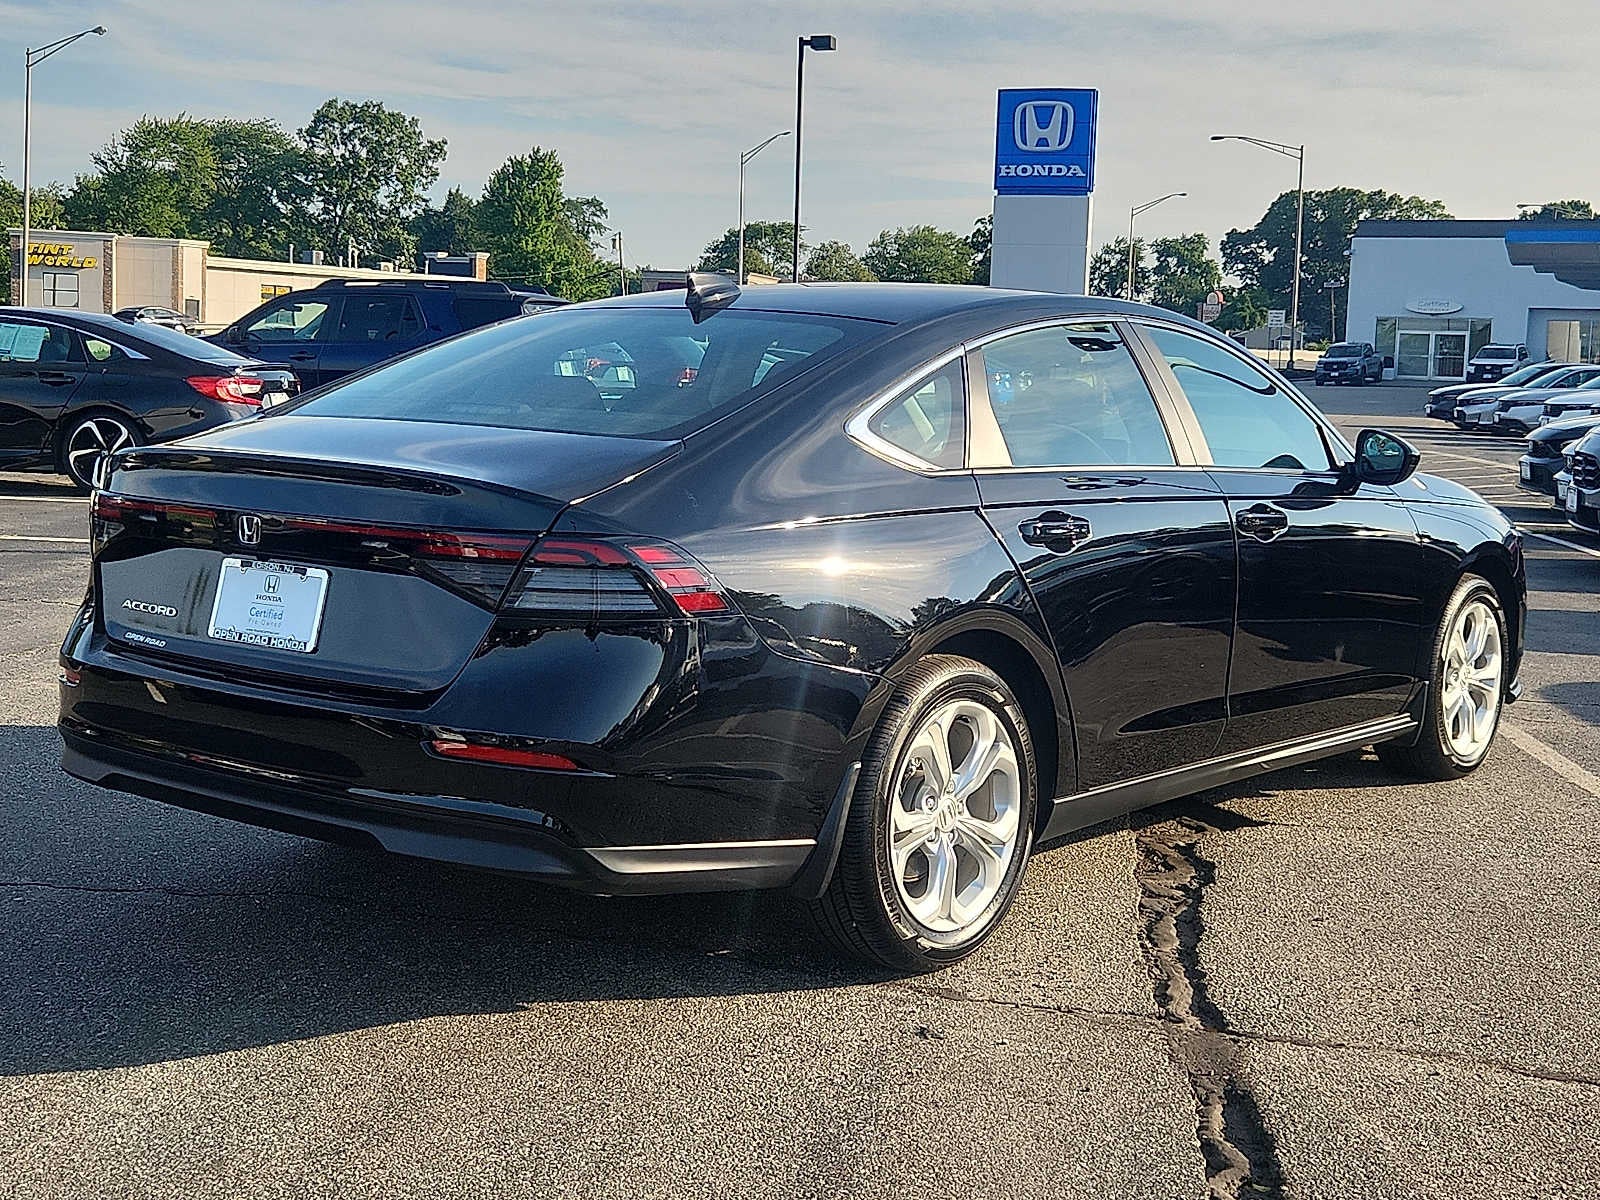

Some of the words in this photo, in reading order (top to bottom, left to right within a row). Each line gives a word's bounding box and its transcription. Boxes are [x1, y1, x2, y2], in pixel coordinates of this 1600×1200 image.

[999, 164, 1086, 177] HONDA
[28, 243, 74, 255] TINT
[28, 255, 98, 268] WORLD
[256, 594, 282, 603] HONDA
[121, 599, 178, 617] ACCORD
[249, 606, 284, 620] Certified
[124, 632, 145, 642] OPEN
[144, 637, 166, 648] ROAD
[214, 629, 240, 641] OPEN
[241, 634, 269, 645] ROAD
[271, 639, 306, 651] HONDA
